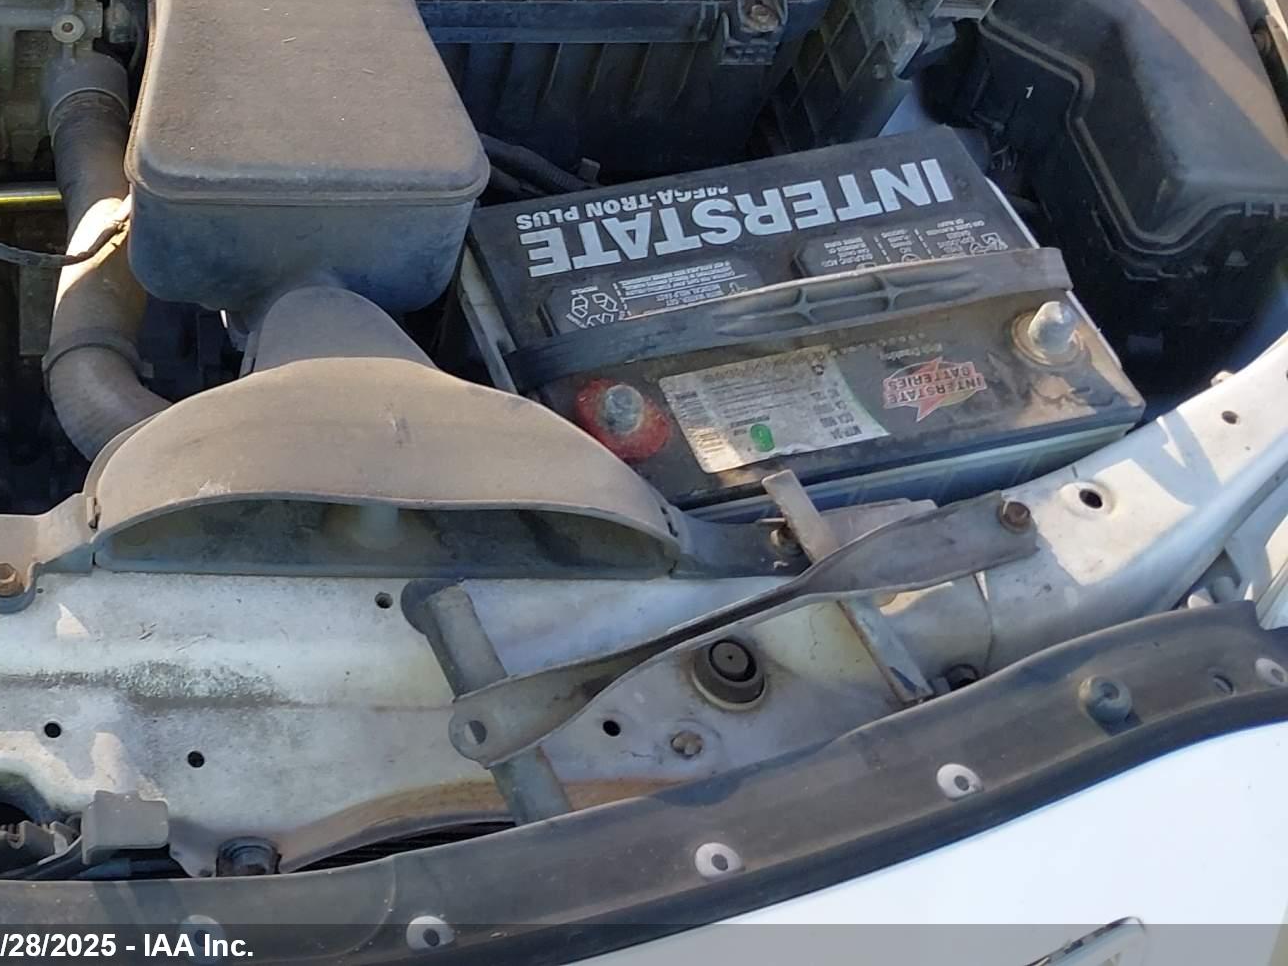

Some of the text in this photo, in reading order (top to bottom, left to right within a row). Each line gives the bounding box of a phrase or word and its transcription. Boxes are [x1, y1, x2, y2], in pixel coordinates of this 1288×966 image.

[515, 205, 581, 231] PLUS
[519, 158, 954, 278] INTERSTATE
[886, 377, 982, 403] INTERSTATE
[887, 366, 972, 391] BATTERIES
